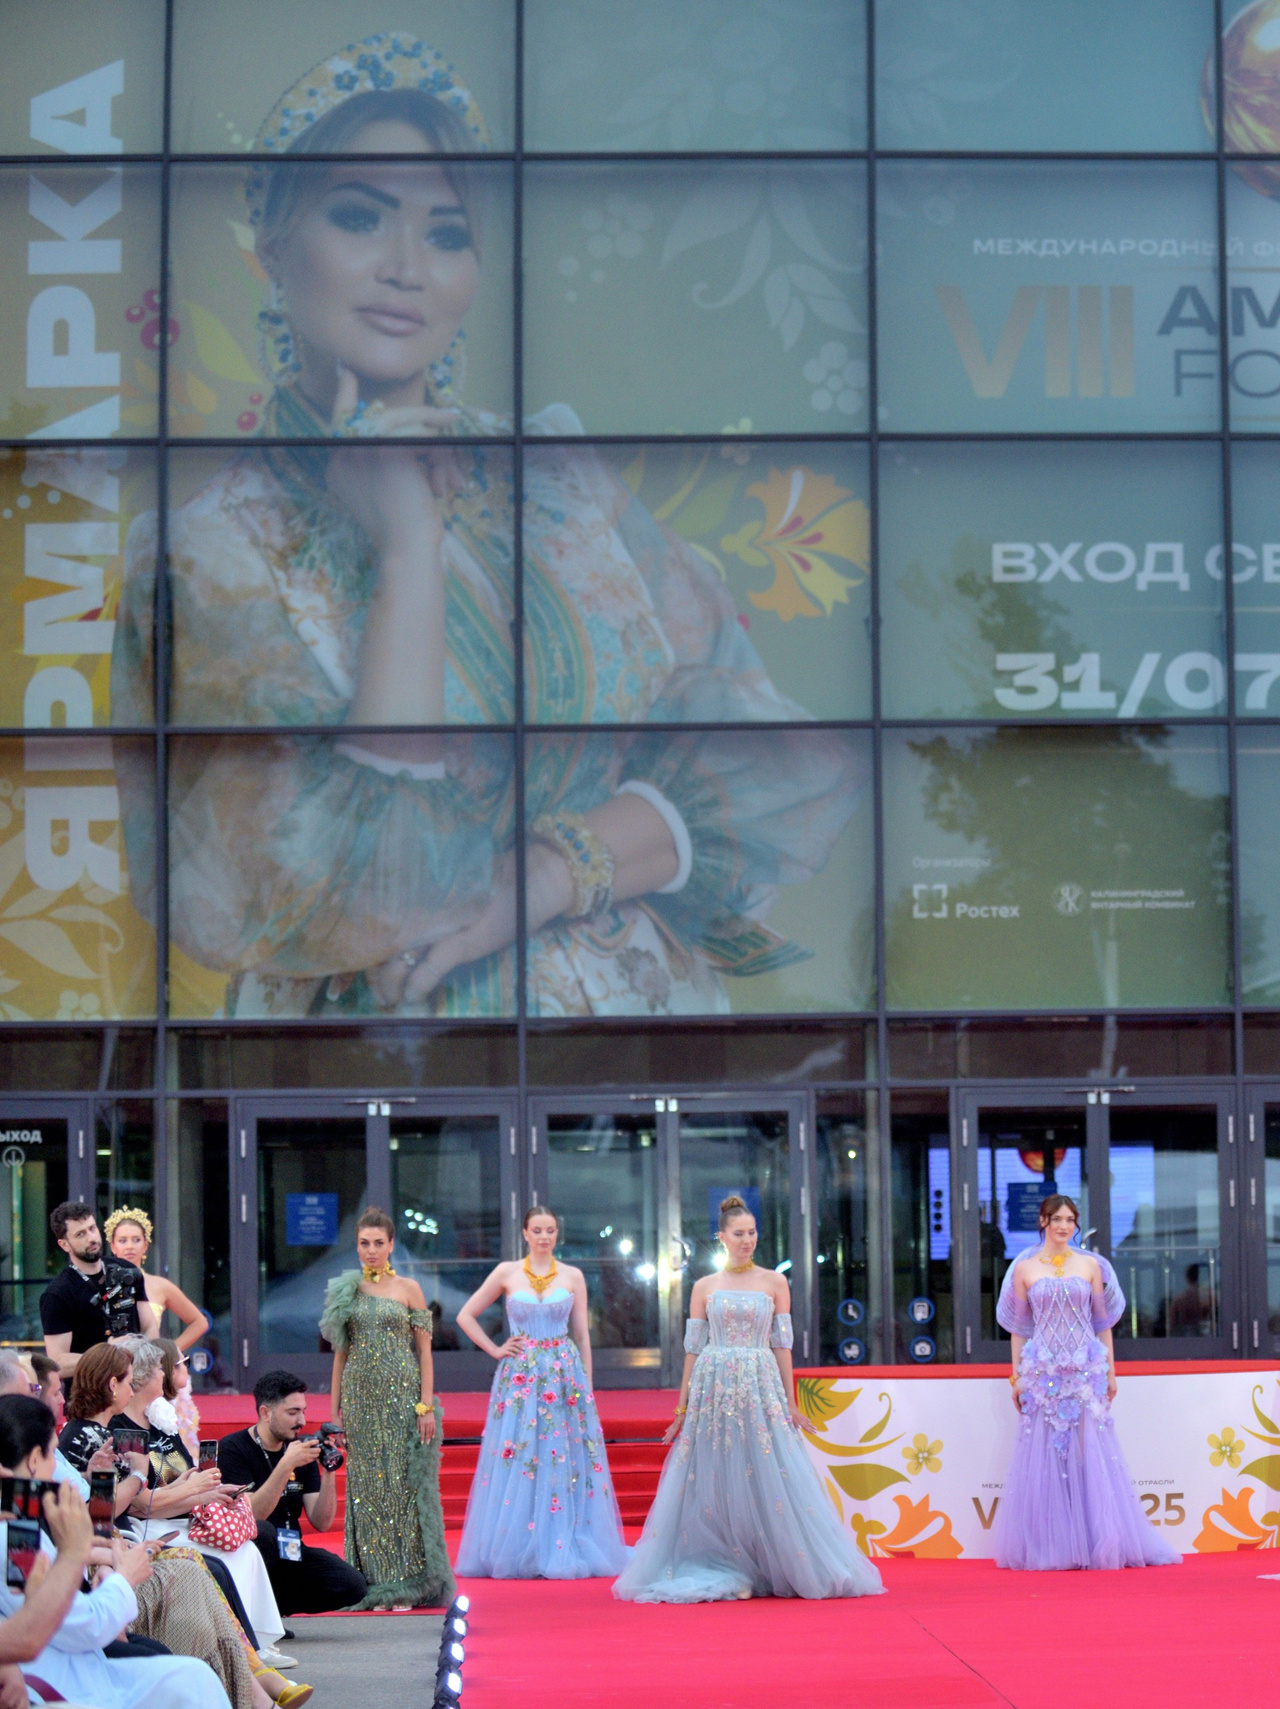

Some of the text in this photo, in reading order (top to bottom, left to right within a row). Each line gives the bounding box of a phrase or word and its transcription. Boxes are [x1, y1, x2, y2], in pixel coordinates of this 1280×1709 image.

[935, 285, 1134, 398] VIII
[24, 59, 125, 893] ЯРМАРКА
[992, 542, 1190, 591] ВХОД
[955, 902, 1020, 919] Ростех
[1139, 1492, 1186, 1527] 25
